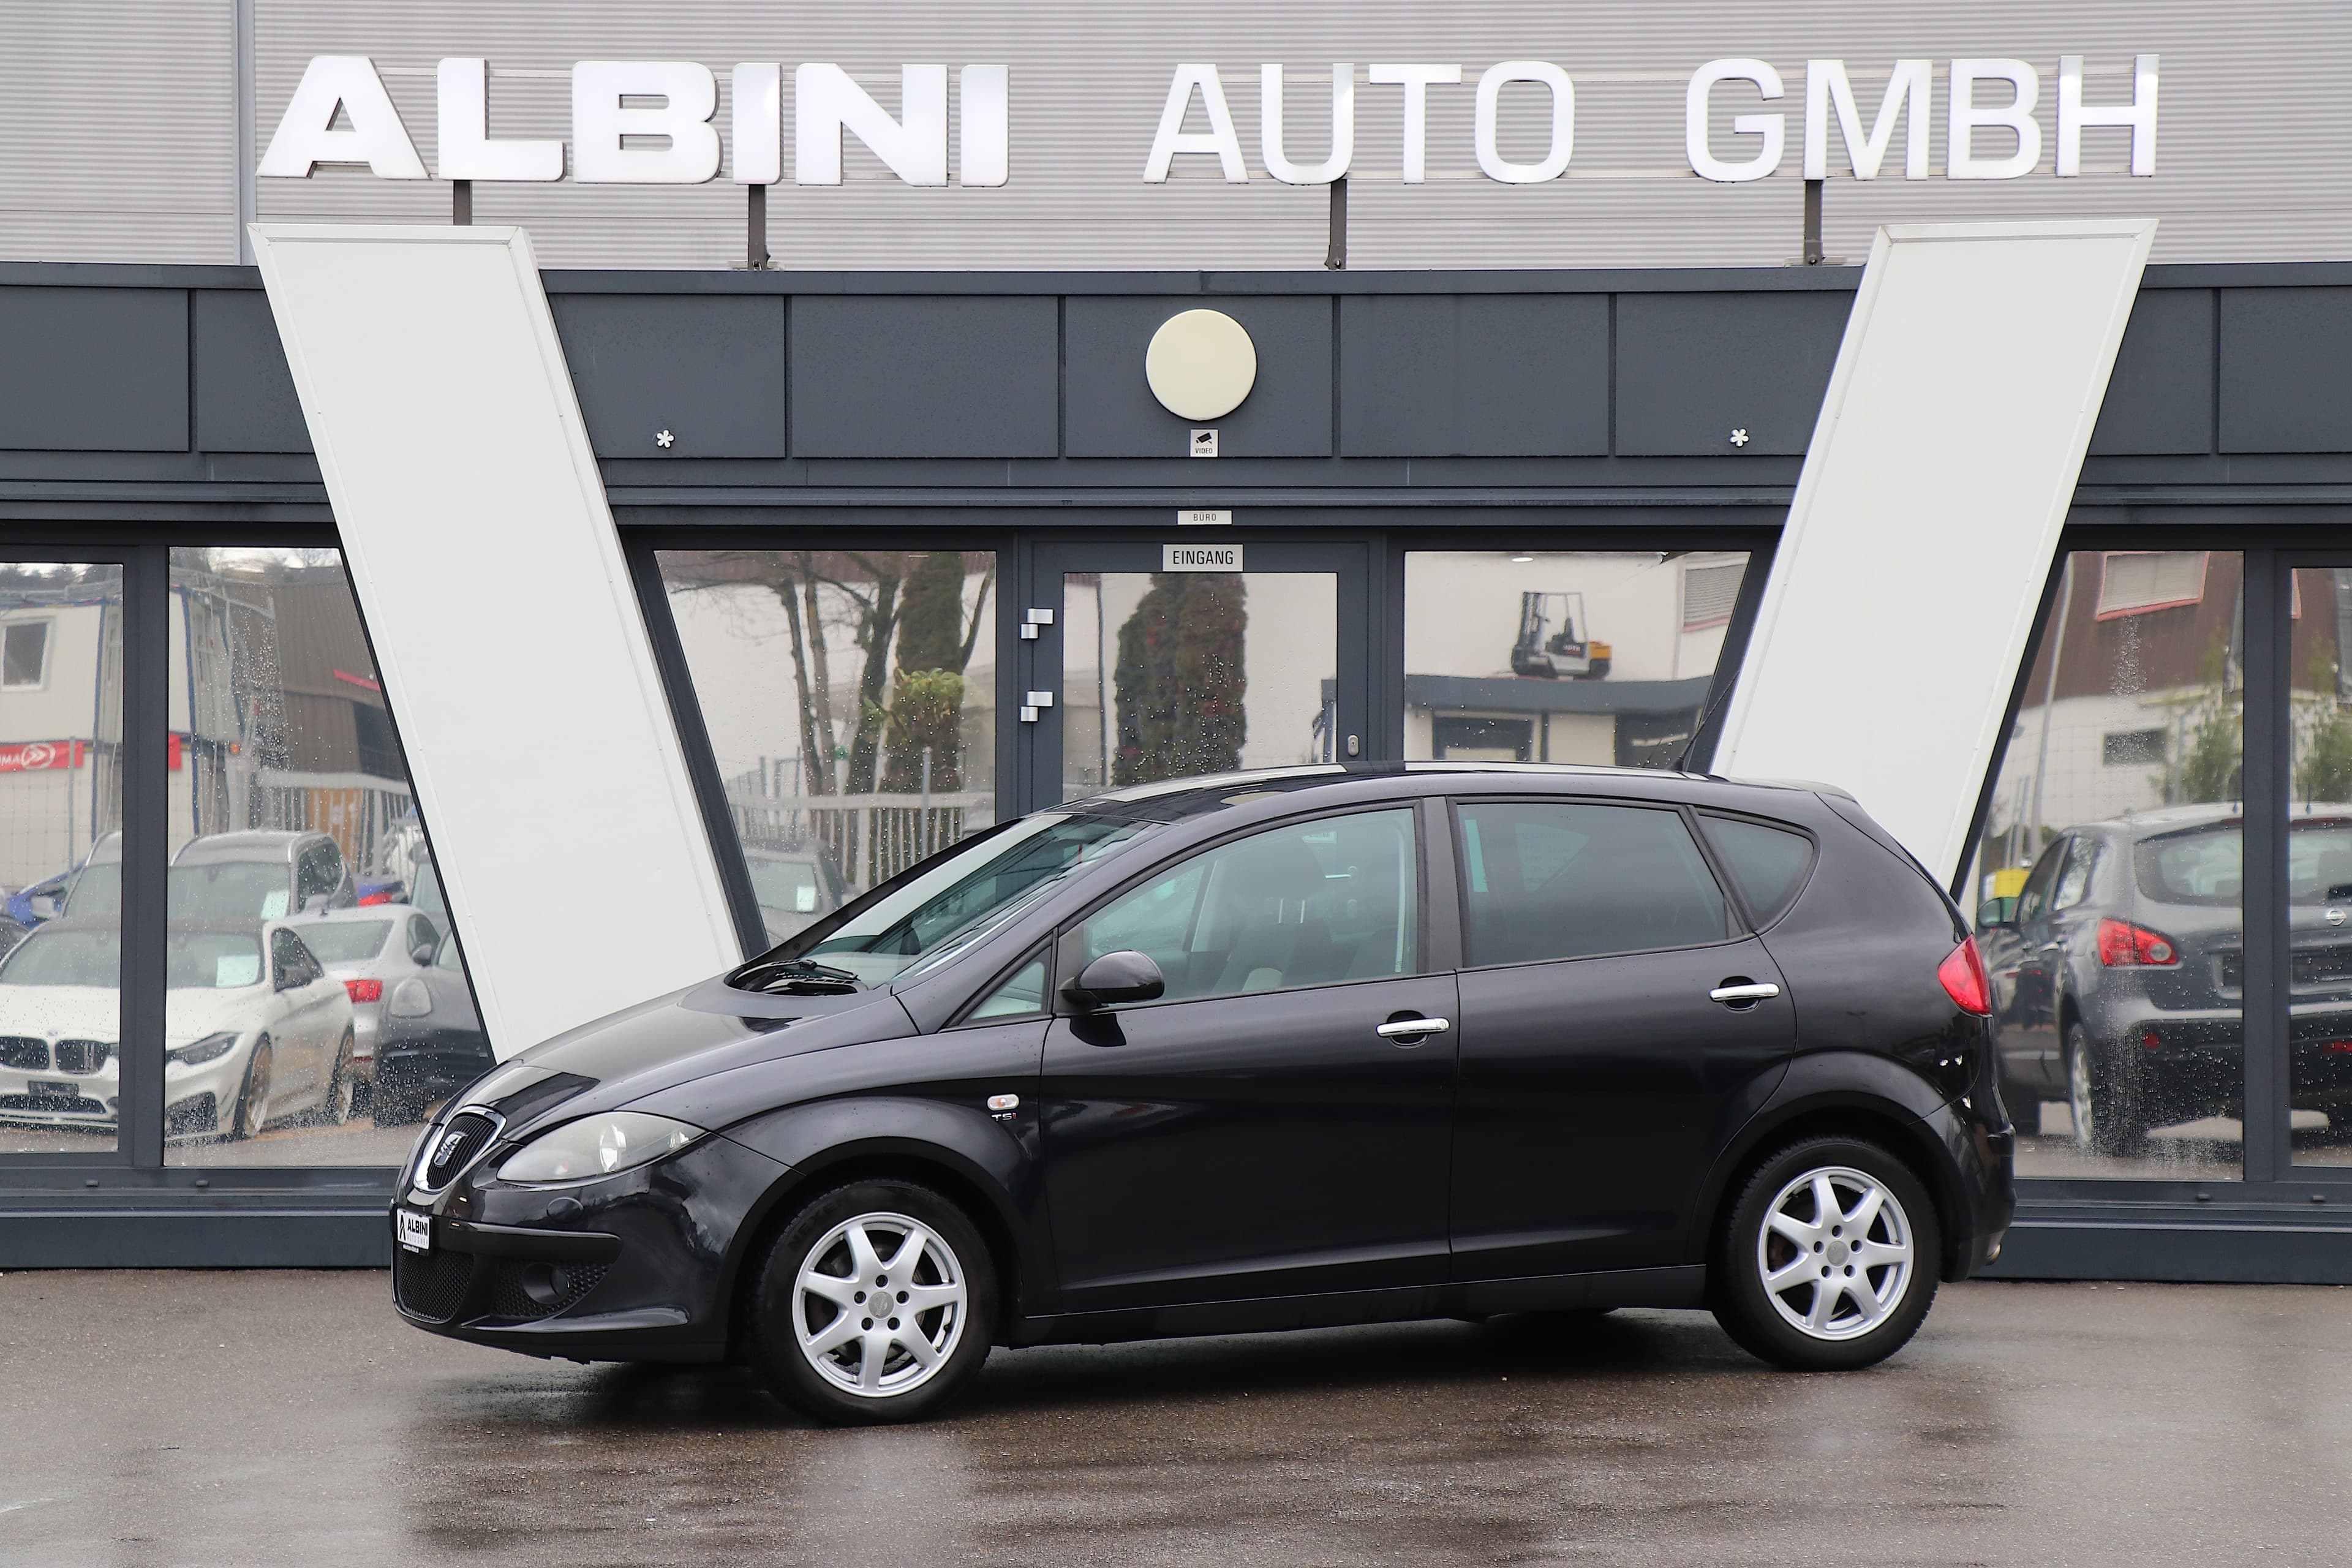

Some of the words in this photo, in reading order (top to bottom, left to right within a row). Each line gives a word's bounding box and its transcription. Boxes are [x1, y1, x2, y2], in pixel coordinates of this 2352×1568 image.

[255, 55, 1009, 187] ALBINI
[1143, 60, 1575, 184] AUTO
[1686, 54, 2160, 183] GMBH
[1193, 512, 1216, 521] BÜRO
[1173, 550, 1234, 565] EINGANG
[992, 1113, 1017, 1121] TSI
[407, 1218, 428, 1236] ALBINI
